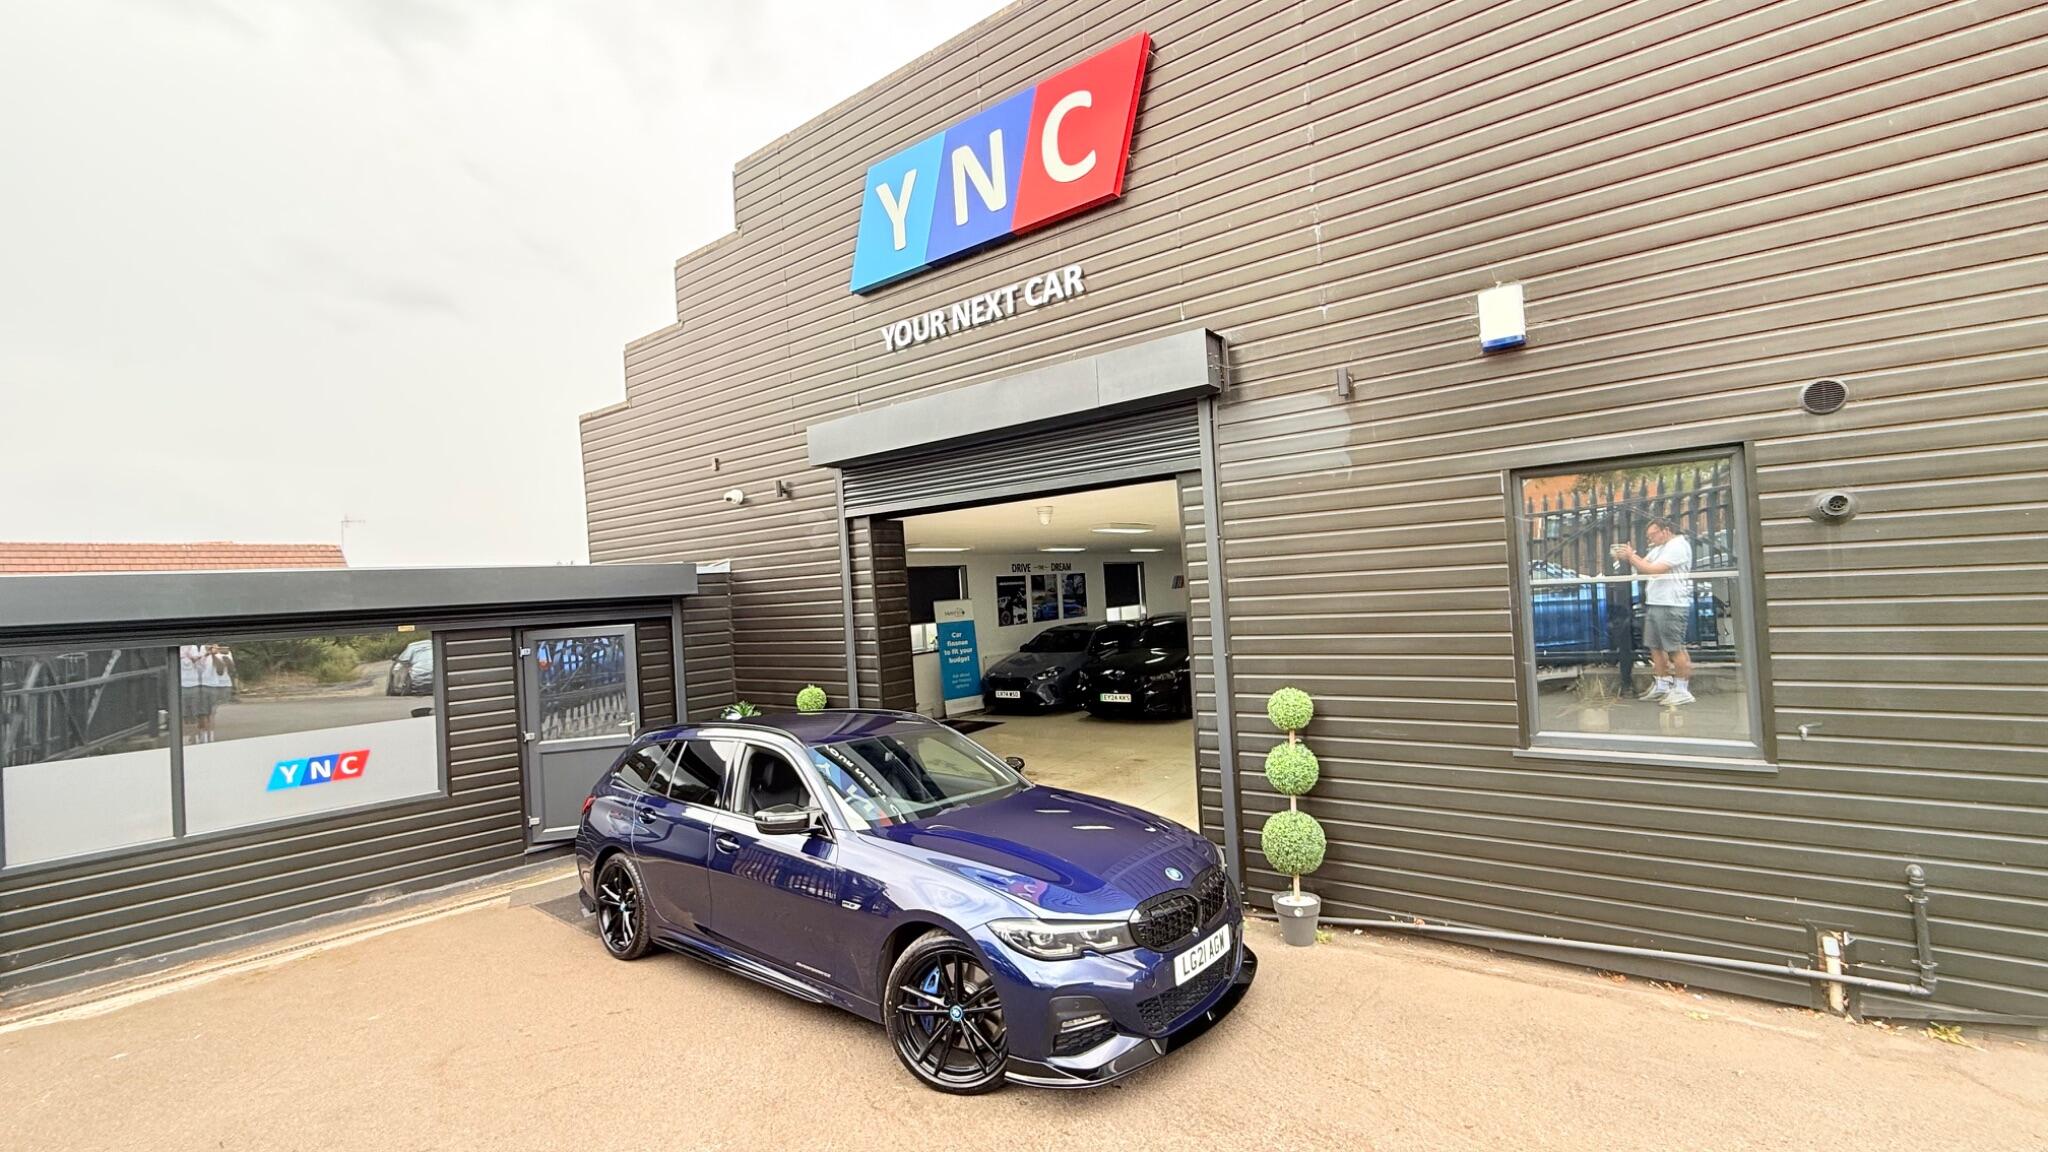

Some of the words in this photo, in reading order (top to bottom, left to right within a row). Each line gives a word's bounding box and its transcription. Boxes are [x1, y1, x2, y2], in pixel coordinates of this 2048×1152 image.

[875, 90, 1096, 251] YNC
[881, 309, 946, 351] YOUR
[951, 285, 1019, 331] NEXT
[1024, 264, 1085, 307] CAR
[1011, 563, 1031, 573] DRIVE
[1050, 562, 1071, 571] DREAM
[948, 656, 970, 664] budget
[959, 647, 973, 656] your
[280, 756, 358, 784] YNC
[1182, 943, 1206, 976] LG21
[1209, 931, 1224, 959] AGW
